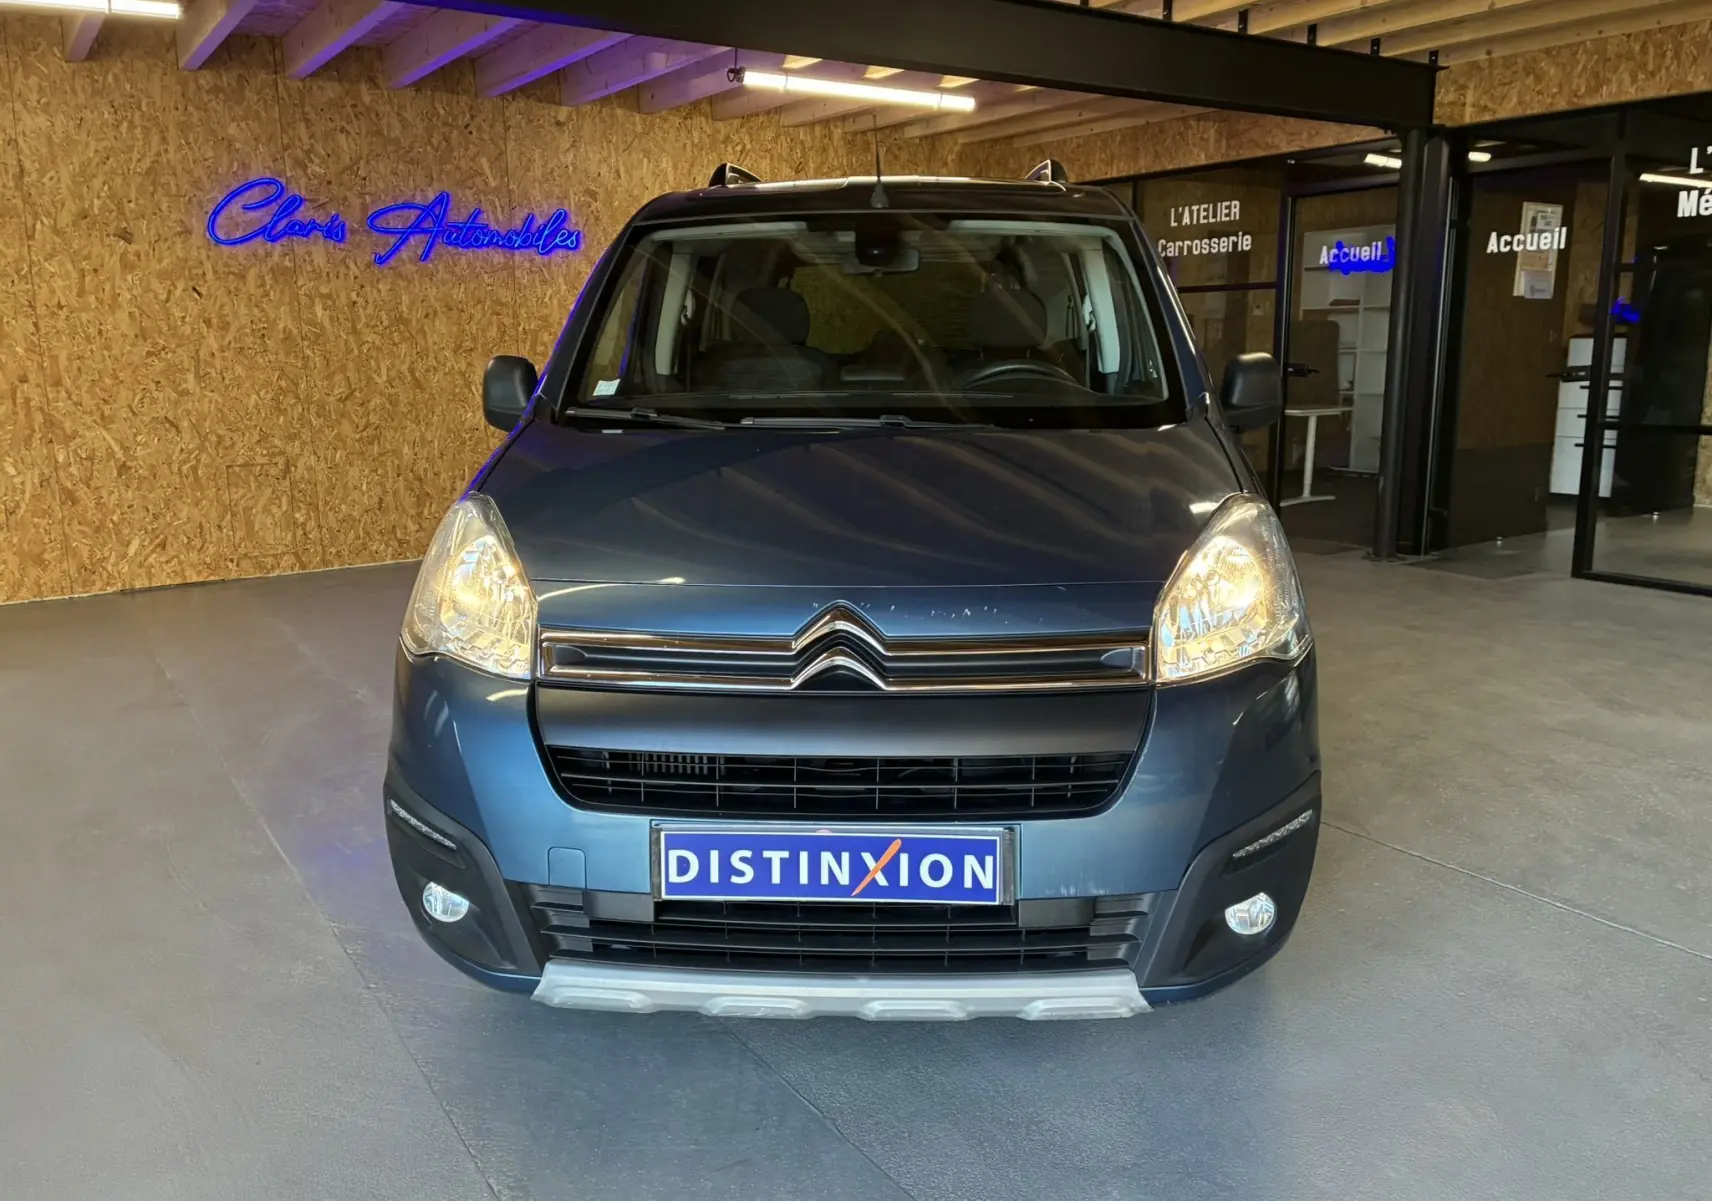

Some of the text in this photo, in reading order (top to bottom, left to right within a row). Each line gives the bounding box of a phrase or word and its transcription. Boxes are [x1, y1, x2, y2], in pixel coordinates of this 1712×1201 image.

[206, 176, 582, 266] Claris Automobiles
[1170, 200, 1241, 227] L'ATELIER
[1157, 231, 1252, 258] Carrosserie
[1319, 241, 1382, 265] Accueil
[1486, 226, 1568, 254] Accueil
[667, 838, 995, 897] DISTINXION
